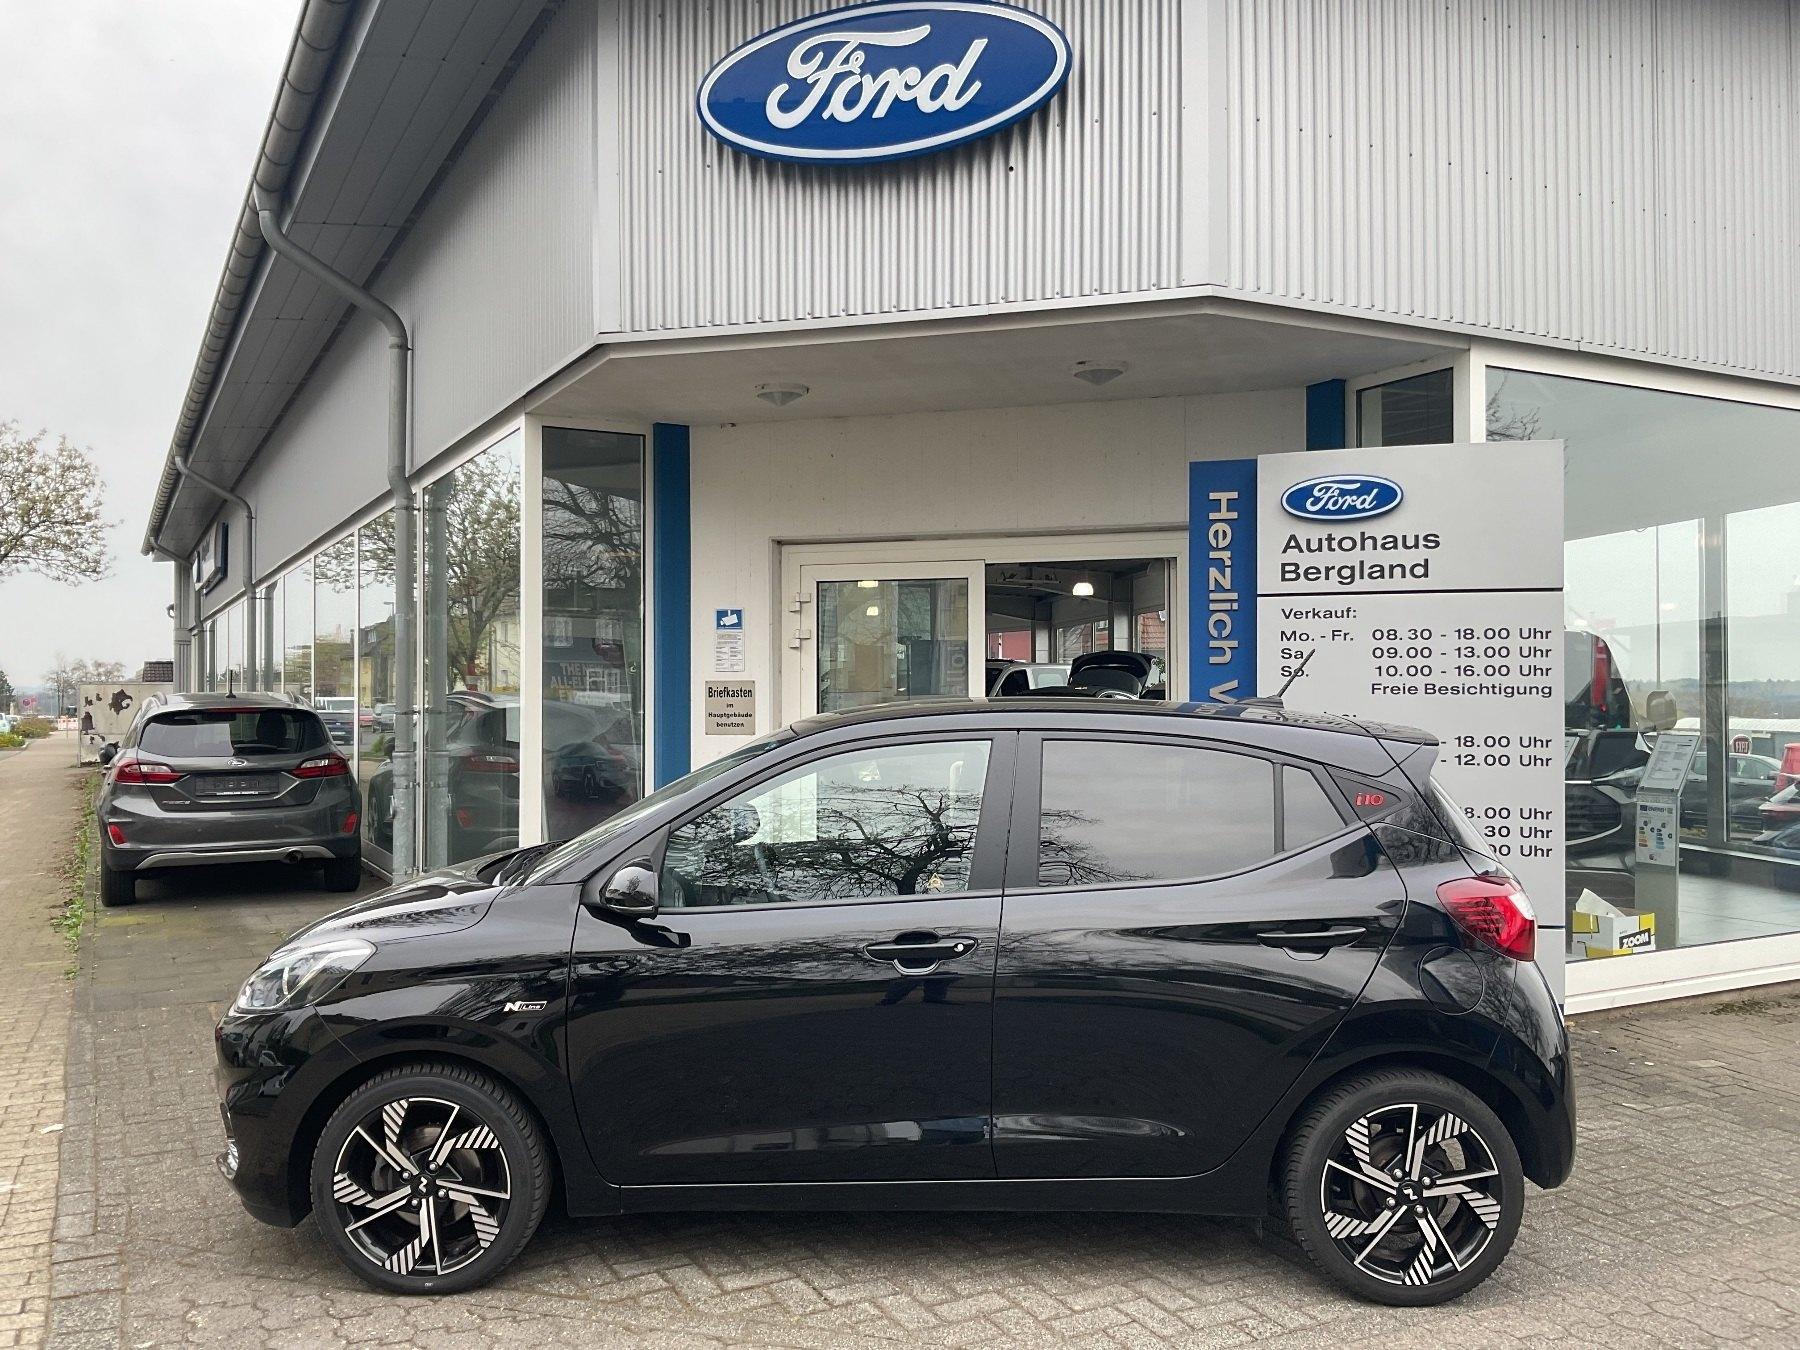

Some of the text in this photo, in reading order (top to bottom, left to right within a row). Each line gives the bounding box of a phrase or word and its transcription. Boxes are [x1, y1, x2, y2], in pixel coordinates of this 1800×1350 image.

[765, 24, 989, 130] Ford
[1305, 482, 1379, 512] Ford
[1281, 531, 1441, 554] Autohaus
[1208, 491, 1239, 664] Herzlich
[1280, 558, 1429, 585] Bergland
[1281, 607, 1357, 619] Verkauf:
[1280, 630, 1315, 641] Mo.
[1331, 629, 1354, 641] Fr.
[1372, 628, 1432, 640] 08.30
[1454, 628, 1510, 640] 18.00
[1519, 628, 1552, 640] Uhr
[1280, 648, 1306, 660] Sa
[1372, 646, 1432, 659] 09.00
[1454, 646, 1510, 658] 13.00
[1519, 646, 1552, 658] Uhr
[1374, 665, 1432, 677] 10.00
[1454, 665, 1510, 677] 16.00
[1519, 665, 1552, 677] Uhr
[708, 686, 753, 698] Briefkasten
[1371, 683, 1552, 698] Freie Besichtigung
[1454, 736, 1511, 748] 18.00
[1519, 736, 1552, 748] Uhr
[1454, 754, 1511, 766] 12.00
[1519, 754, 1552, 767] Uhr
[1356, 793, 1384, 806] i10
[1463, 807, 1552, 820] 8.00 Uhr
[1484, 825, 1552, 838] 30 Uhr
[1519, 845, 1552, 857] Uhr
[1622, 931, 1649, 949] ZOOM
[503, 1001, 521, 1012] N
